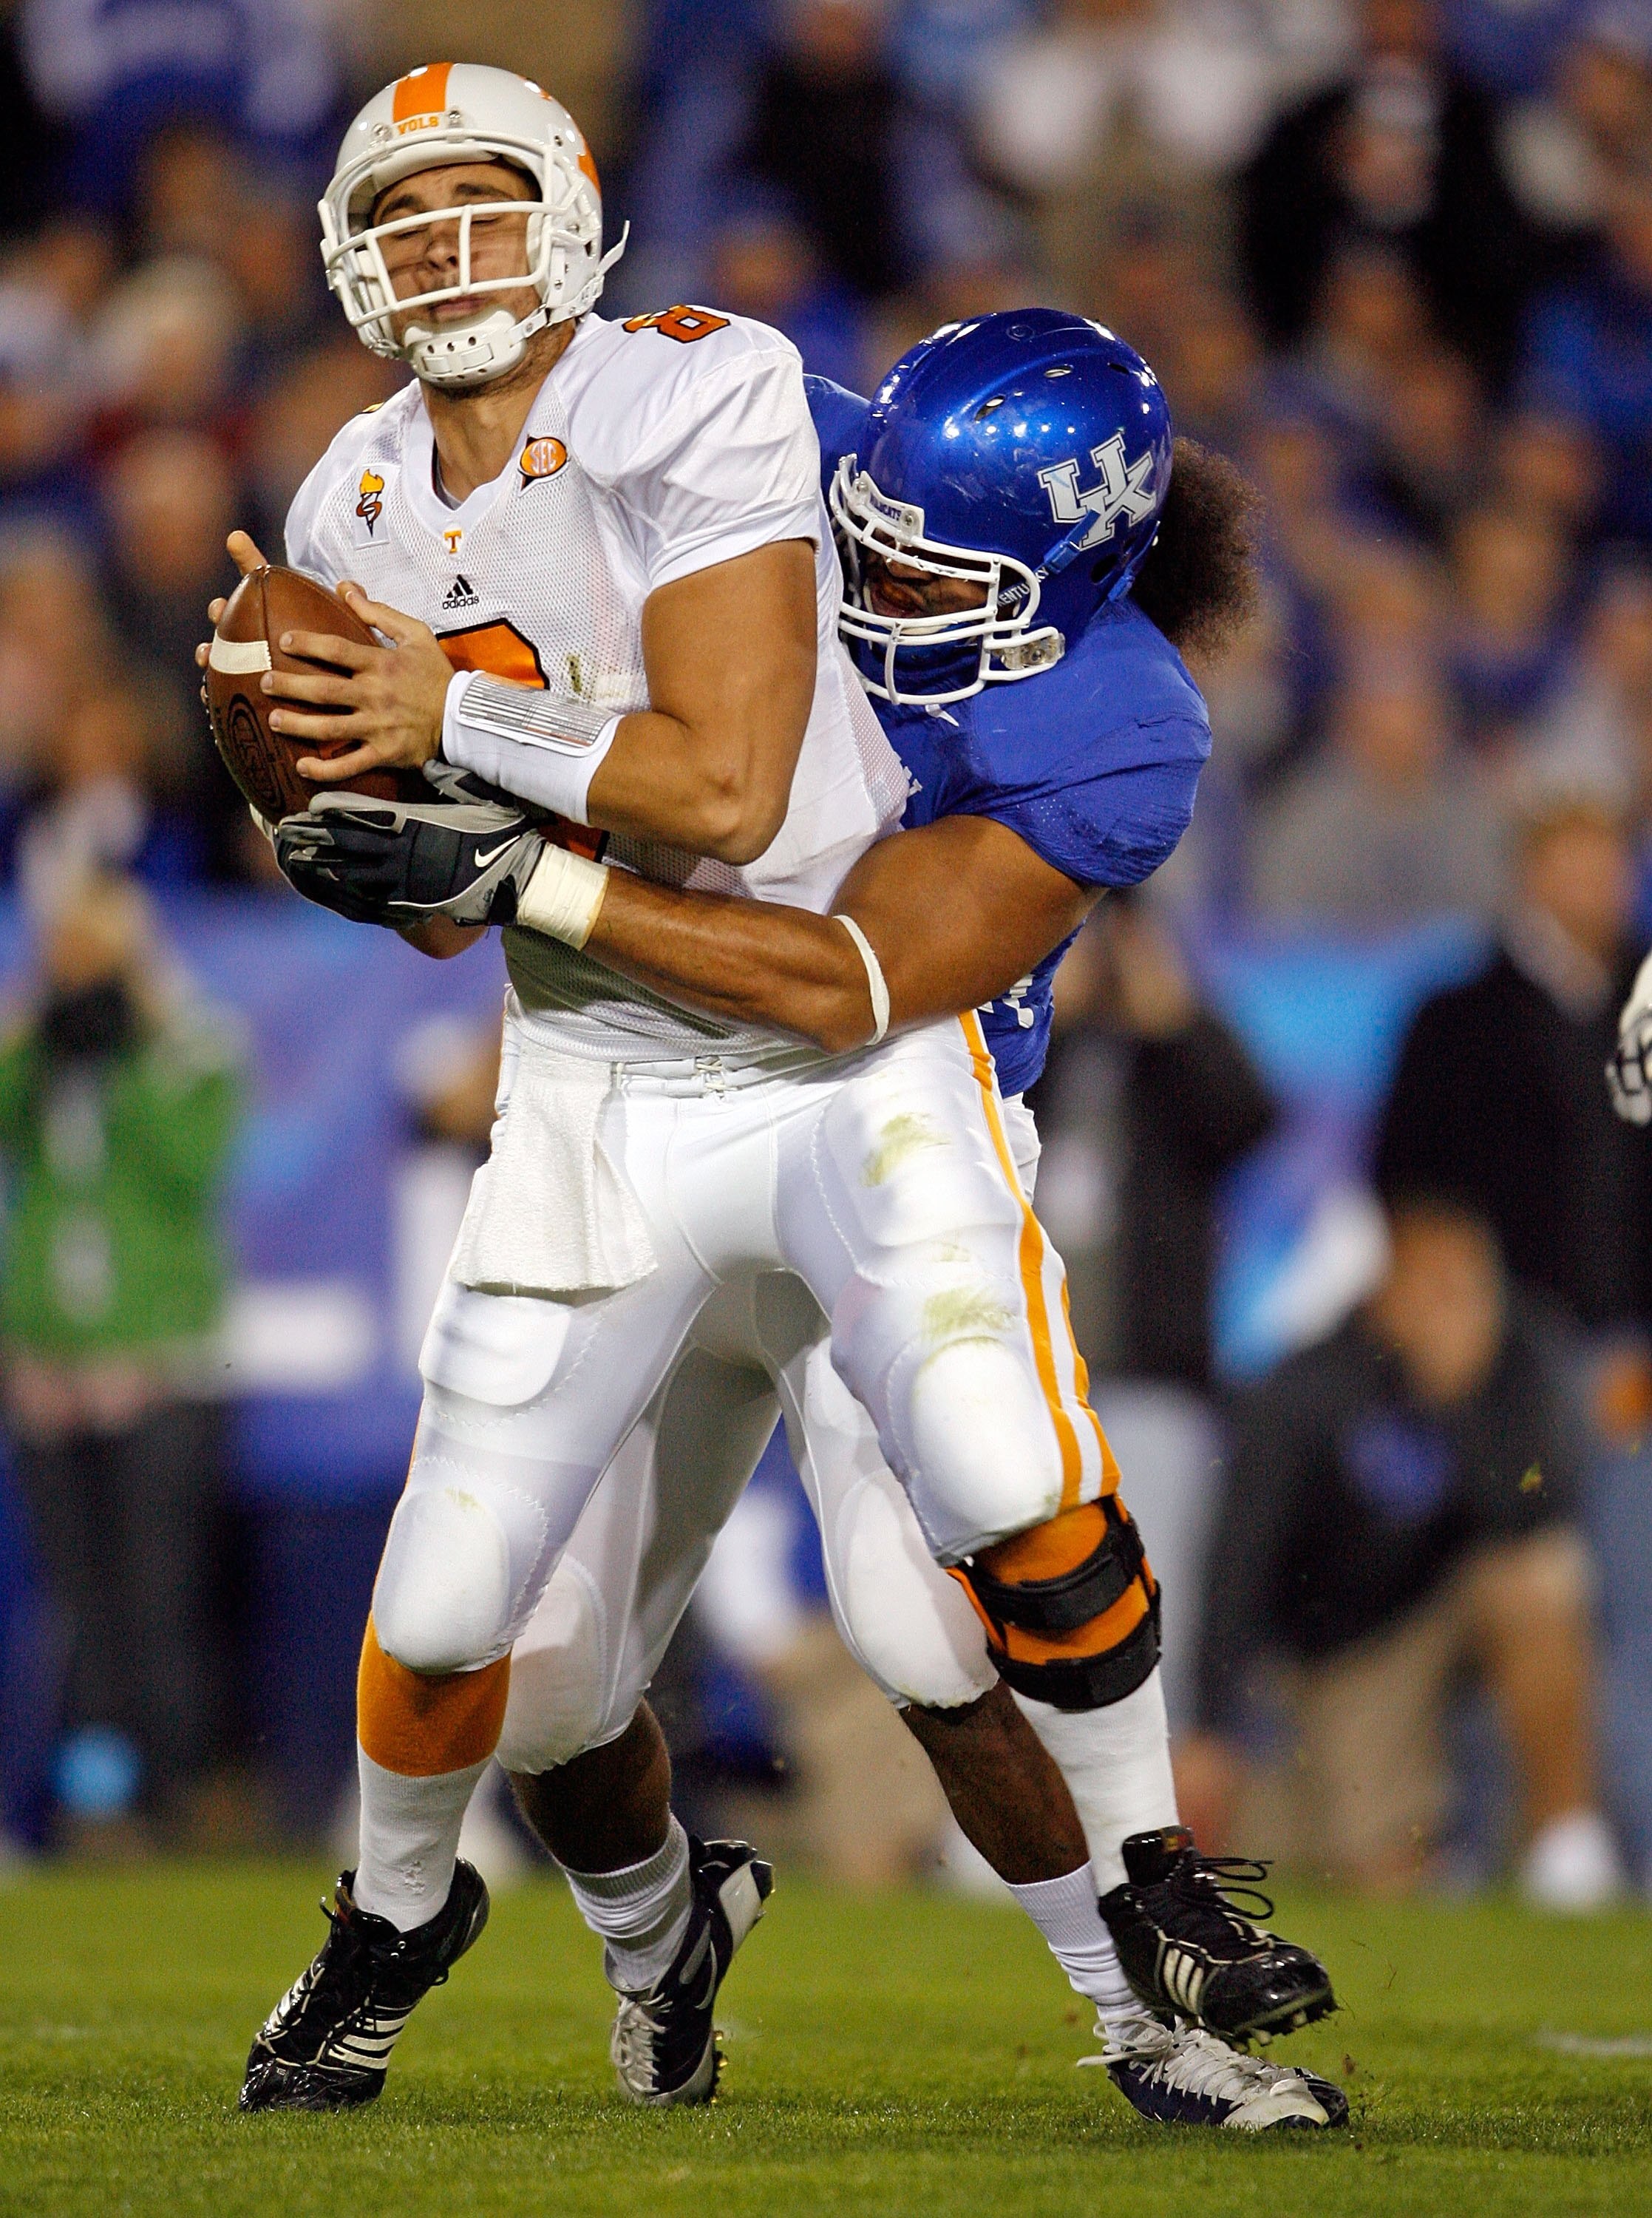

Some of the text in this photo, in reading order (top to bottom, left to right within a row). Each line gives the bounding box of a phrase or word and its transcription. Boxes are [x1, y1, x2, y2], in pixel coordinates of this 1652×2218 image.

[398, 116, 439, 135] VOLS
[530, 441, 557, 474] SEC
[1037, 433, 1157, 552] UK
[443, 530, 462, 554] T
[997, 566, 1049, 606] KENTUKY
[443, 596, 480, 609] adidas
